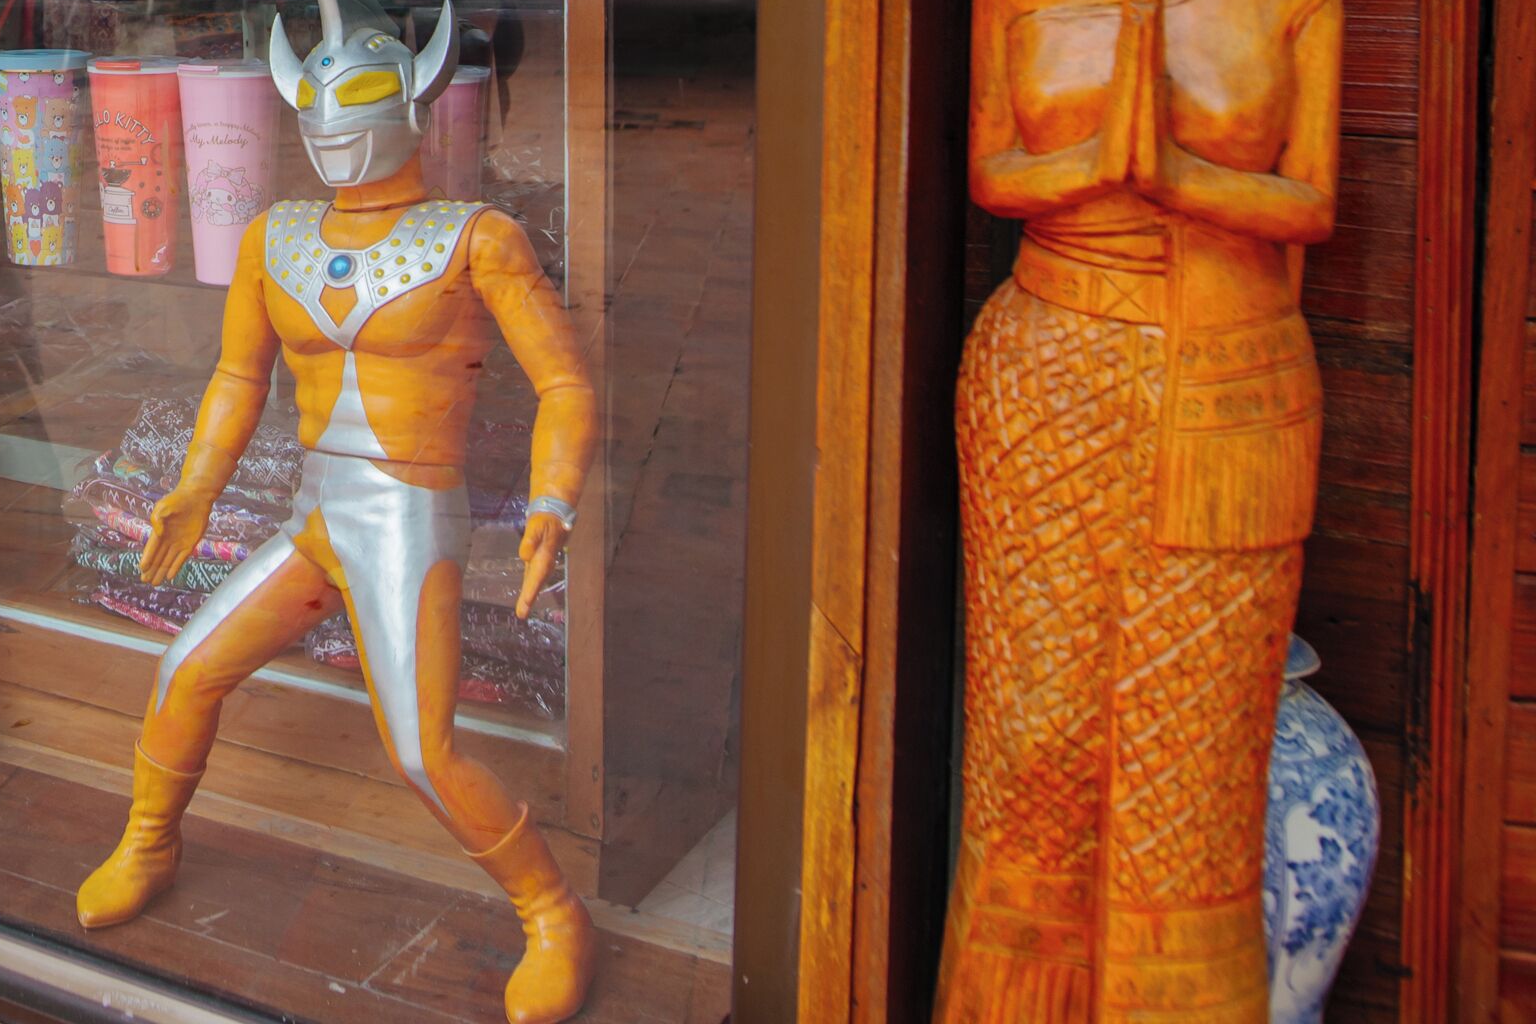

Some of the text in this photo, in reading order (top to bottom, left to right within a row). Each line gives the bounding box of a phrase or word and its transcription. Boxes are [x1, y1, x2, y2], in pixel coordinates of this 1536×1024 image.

[114, 110, 157, 145] KITTY
[190, 133, 249, 149] My Melody
